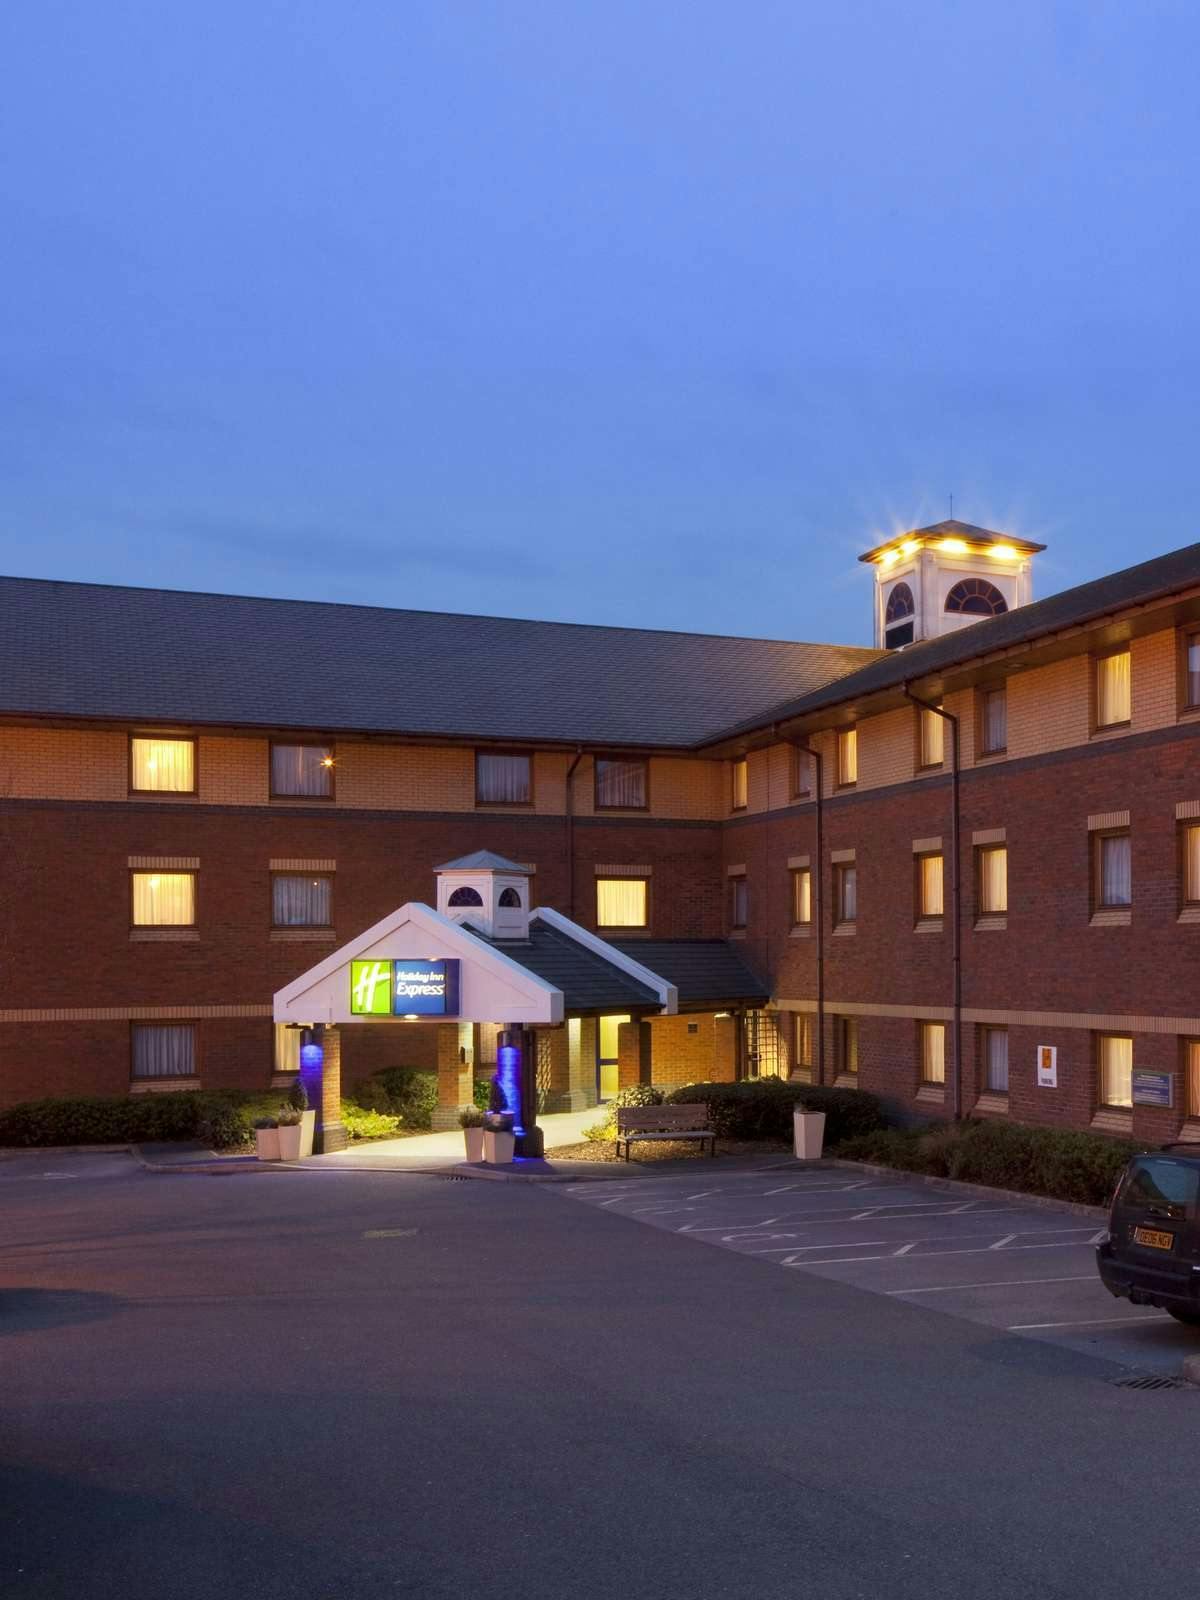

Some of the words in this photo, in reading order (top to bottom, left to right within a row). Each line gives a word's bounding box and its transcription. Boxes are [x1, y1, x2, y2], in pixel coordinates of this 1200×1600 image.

[397, 971, 429, 983] Holiday
[430, 971, 444, 981] Inn
[397, 982, 445, 998] Express
